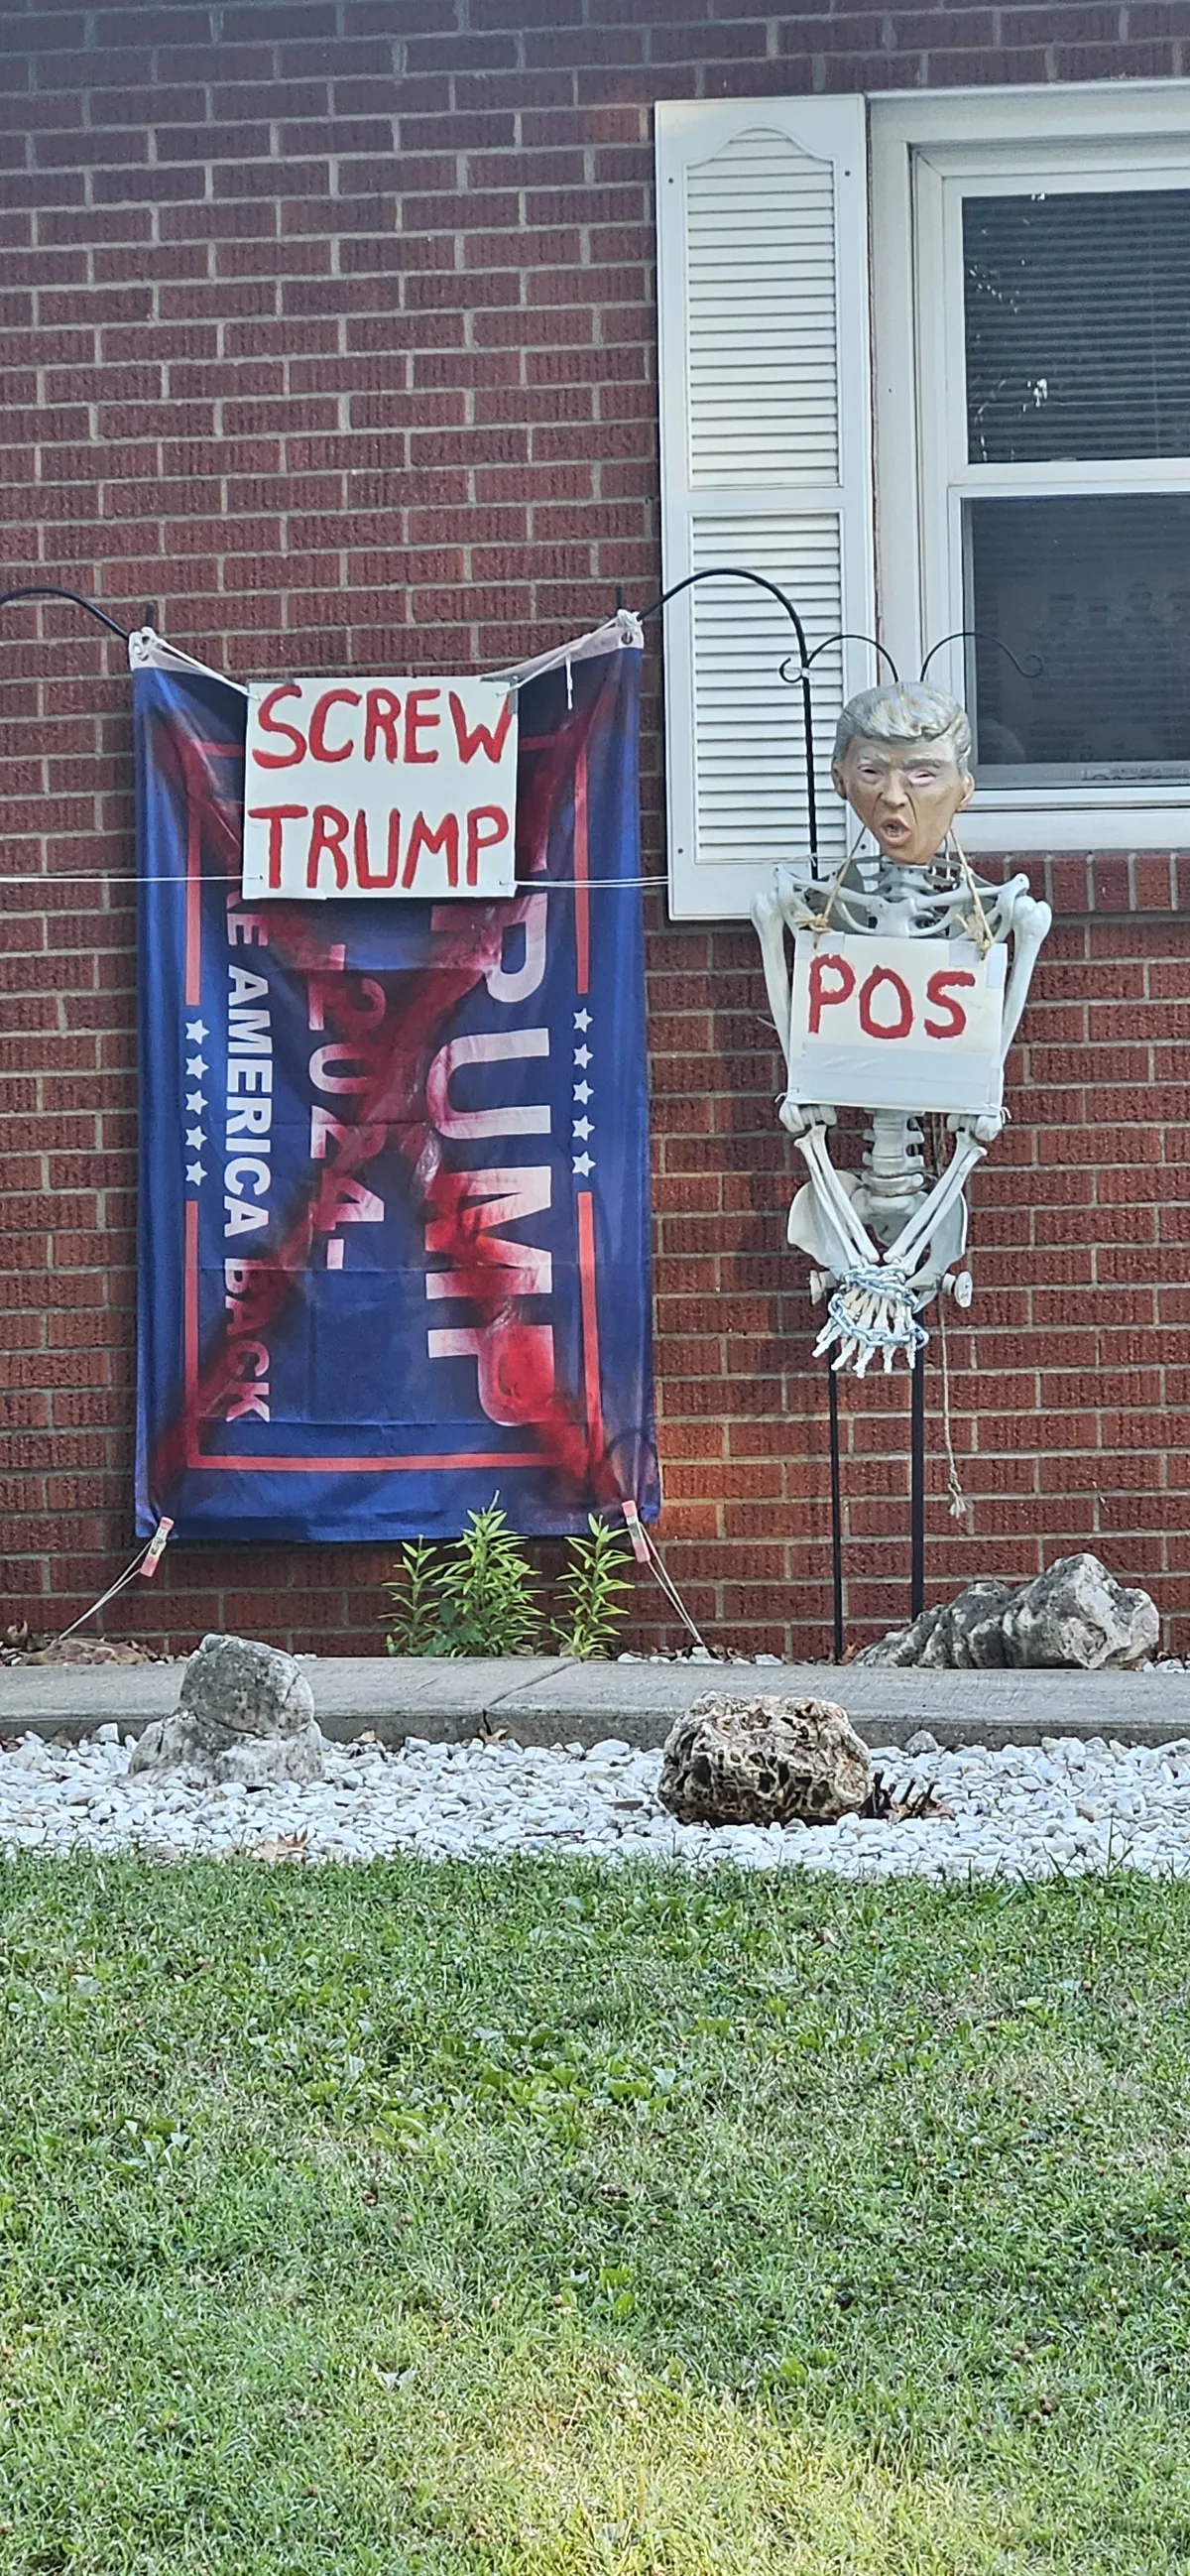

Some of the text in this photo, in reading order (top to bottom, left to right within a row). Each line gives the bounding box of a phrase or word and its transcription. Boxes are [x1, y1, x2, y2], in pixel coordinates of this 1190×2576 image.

[252, 684, 513, 769] SCREW
[248, 804, 509, 889] TRUMP
[808, 953, 976, 1040] POS
[223, 964, 273, 1238] AMERICA
[425, 778, 555, 1426] RUMP
[224, 1258, 271, 1423] BACK
